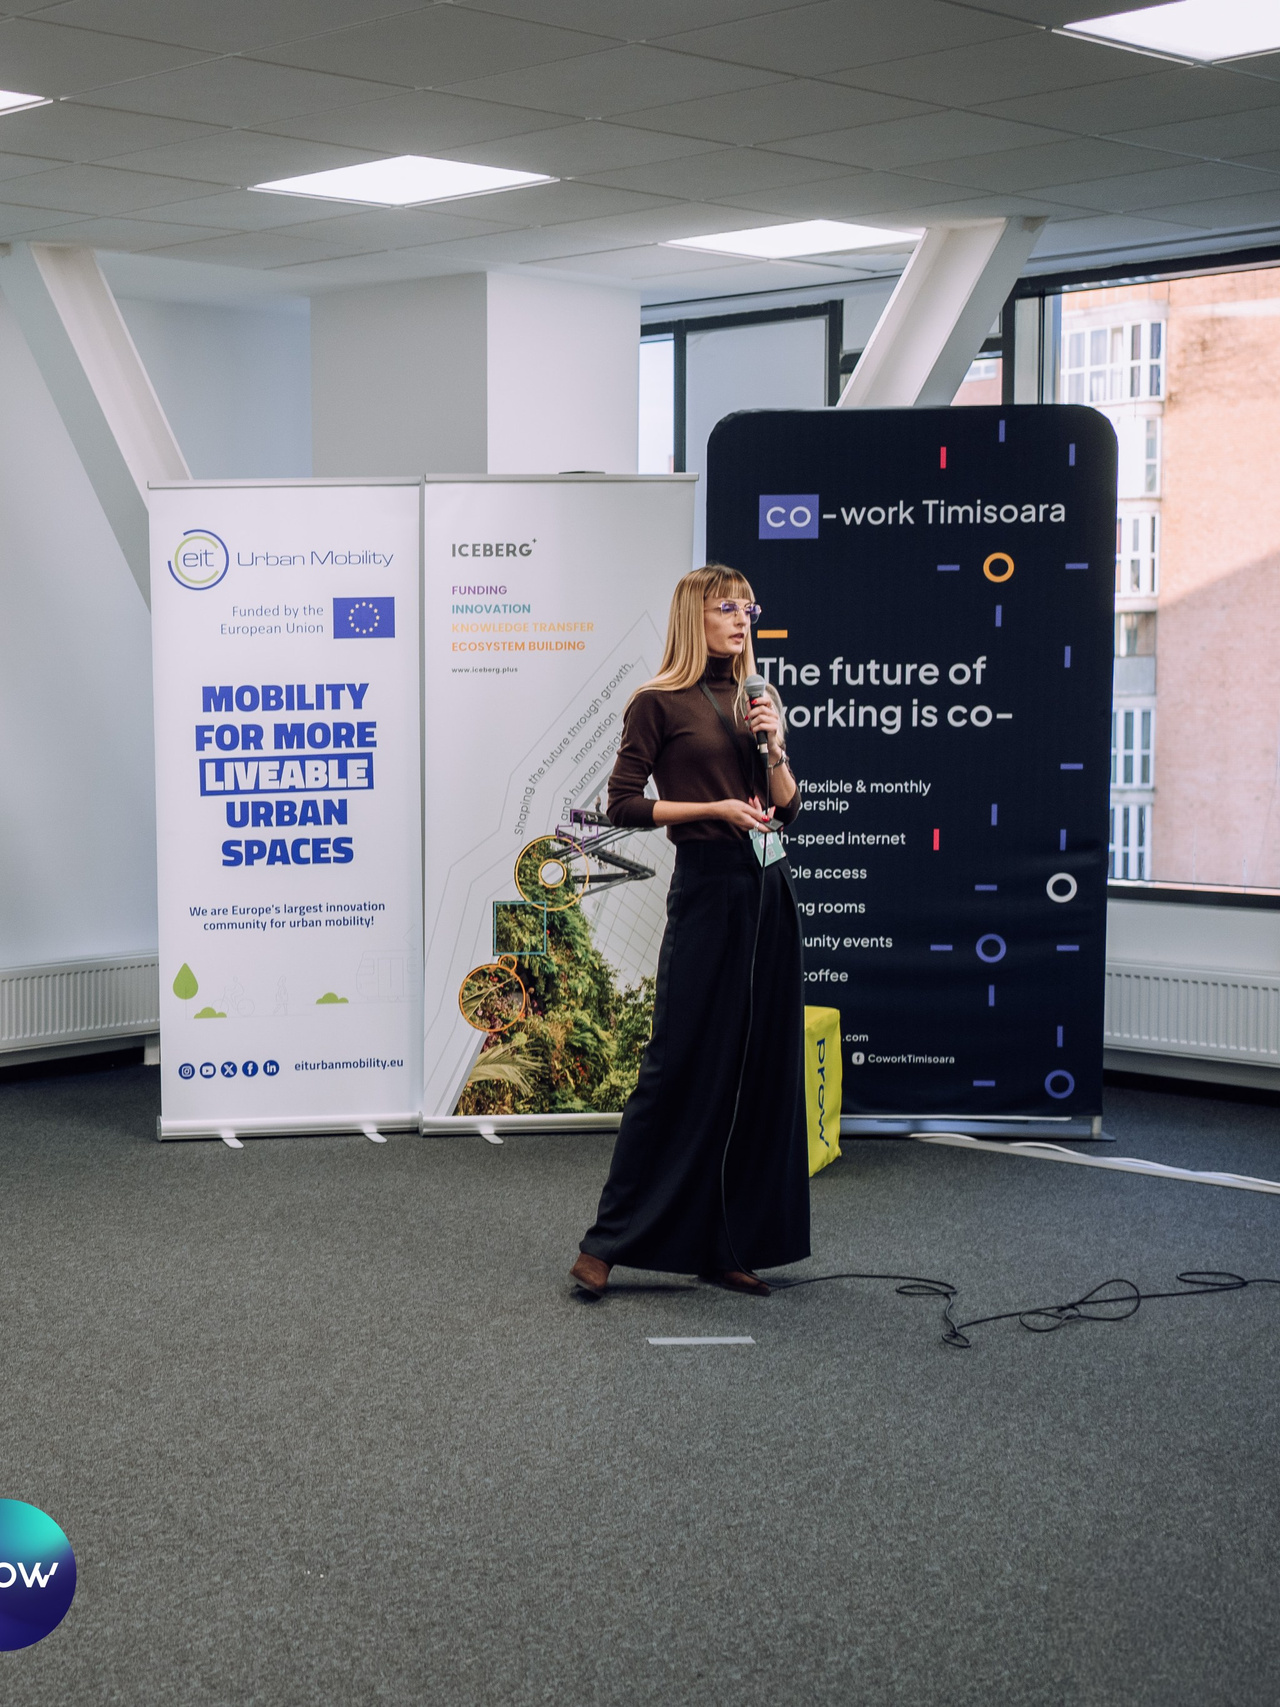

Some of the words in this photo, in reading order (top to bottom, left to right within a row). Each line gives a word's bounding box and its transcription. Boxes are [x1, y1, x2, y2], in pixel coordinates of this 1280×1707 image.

[922, 500, 1065, 524] Timisoara
[183, 550, 214, 567] eit
[238, 552, 305, 566] Urban
[311, 551, 393, 567] Mobility
[452, 586, 507, 595] FUNDING
[233, 605, 279, 617] Funded
[285, 605, 298, 618] by
[303, 605, 323, 615] the
[452, 604, 530, 613] INNOVATION
[221, 624, 281, 636] European
[287, 623, 323, 633] Union
[452, 623, 528, 632] KNOWLEDGE
[533, 622, 594, 632] TRANSFER
[452, 642, 525, 651] ECOSYSTEM
[529, 641, 585, 650] BUILDING
[757, 656, 821, 687] The
[829, 657, 939, 685] future
[949, 656, 986, 685] of
[202, 683, 369, 712] MOBILITY
[782, 697, 902, 736] orking
[912, 699, 937, 727] is
[947, 705, 1012, 727] co-
[196, 724, 263, 751] FOR
[273, 721, 377, 750] MORE
[571, 711, 618, 765] innovation
[515, 786, 535, 835] Shaping
[529, 767, 545, 784] the
[543, 738, 570, 767] future
[568, 699, 602, 738] through
[601, 663, 634, 700] growth,
[205, 758, 369, 792] LIVEABLE
[560, 797, 571, 821] and
[569, 760, 601, 795] human
[798, 779, 853, 794] flexible
[856, 780, 866, 793] &
[871, 780, 931, 796] monthly
[226, 799, 347, 828] URBAN
[781, 832, 845, 847] h-speed
[848, 832, 905, 845] internet
[222, 837, 353, 866] SPACES
[815, 869, 867, 879] access
[190, 907, 207, 916] We
[232, 905, 280, 917] Europe's
[284, 904, 322, 916] largest
[326, 902, 385, 912] innovation
[819, 903, 865, 913] rooms
[204, 920, 266, 931] community
[271, 919, 286, 928] for
[290, 918, 321, 927] urban
[326, 916, 373, 928] mobility!
[802, 934, 840, 951] unity
[843, 936, 892, 947] events
[295, 1058, 403, 1070] eiturbanmobility.eu
[868, 1054, 954, 1063] CoworkTimisoara
